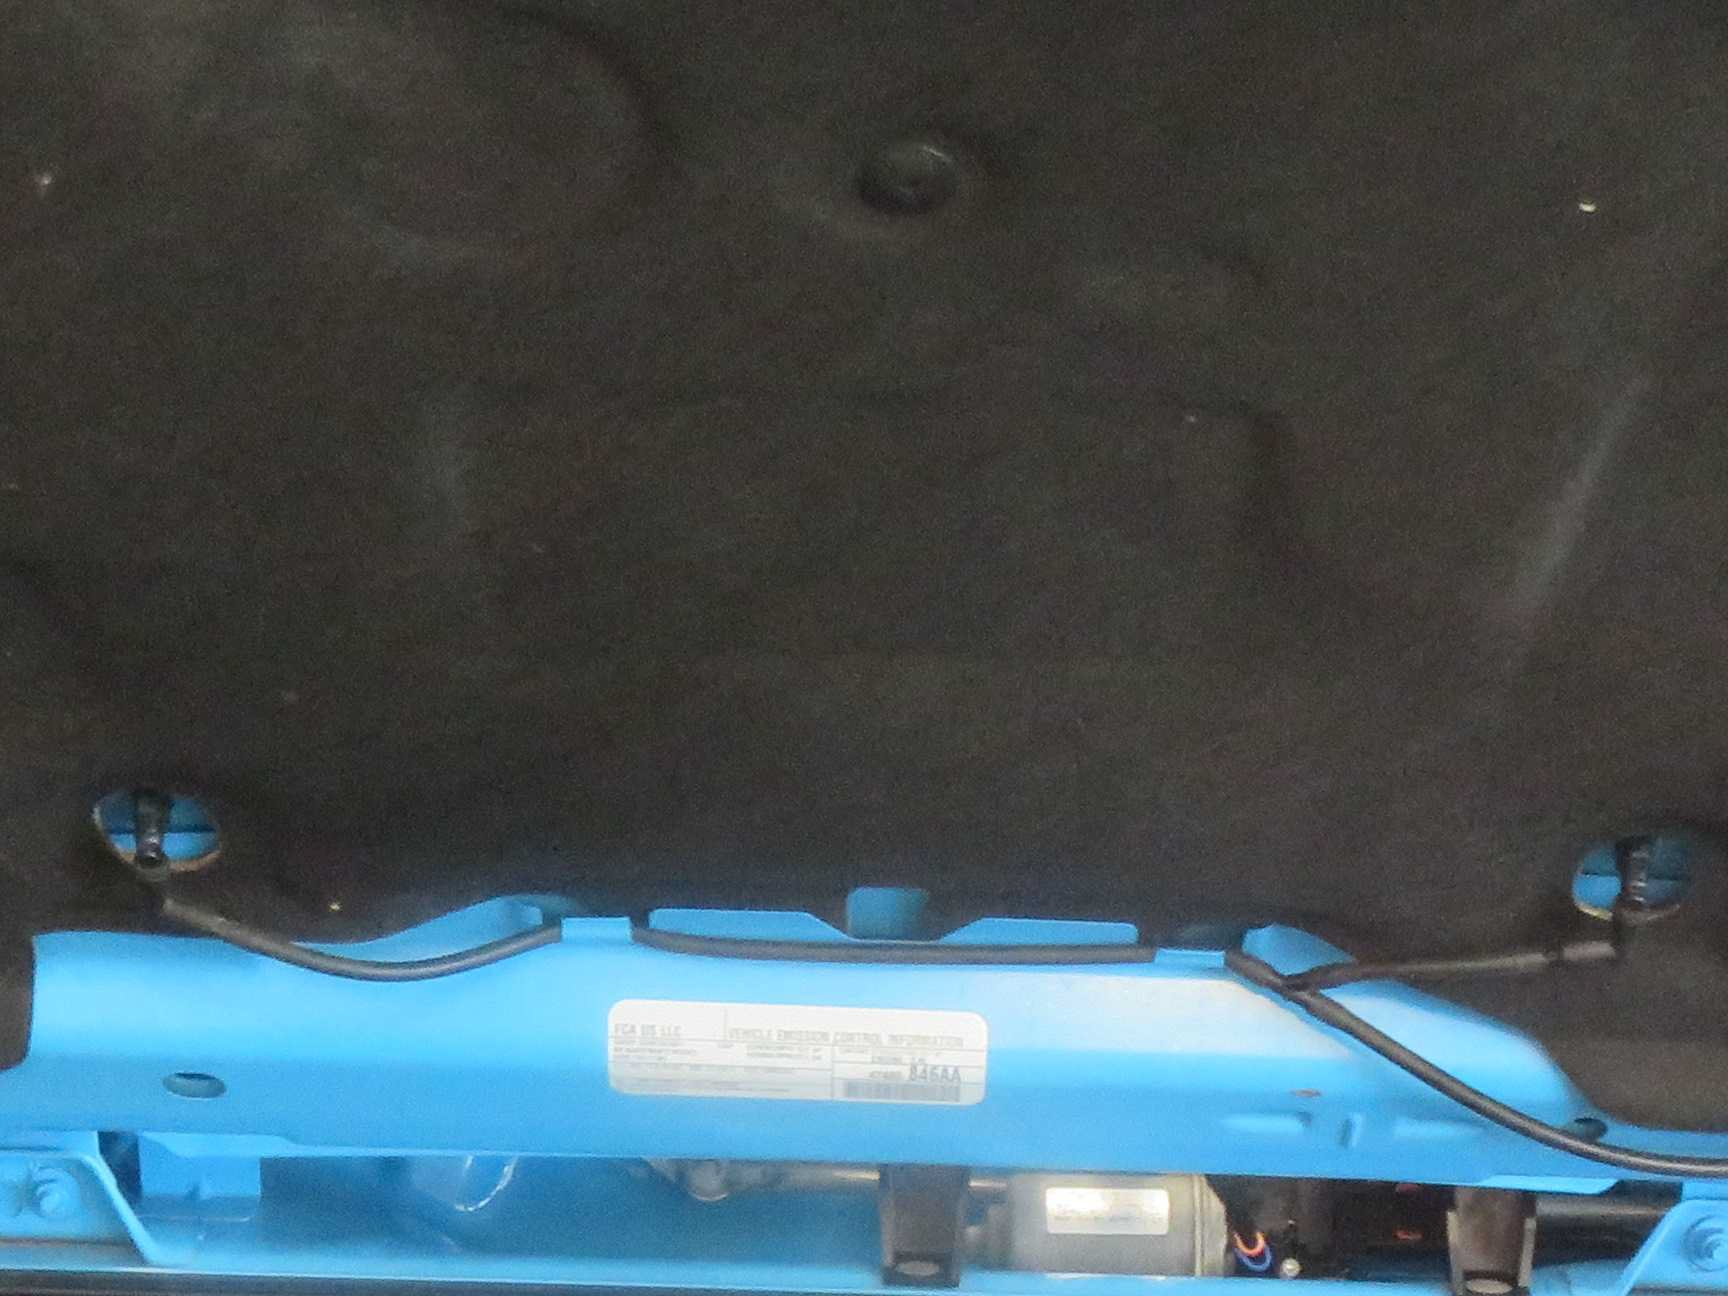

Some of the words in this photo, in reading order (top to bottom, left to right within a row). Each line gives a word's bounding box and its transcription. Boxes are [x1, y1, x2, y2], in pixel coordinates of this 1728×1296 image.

[727, 1027, 773, 1041] VEHICLE
[776, 1029, 830, 1043] EMISSION
[833, 1031, 882, 1046] CONTROL
[887, 1034, 964, 1049] INFORMATION
